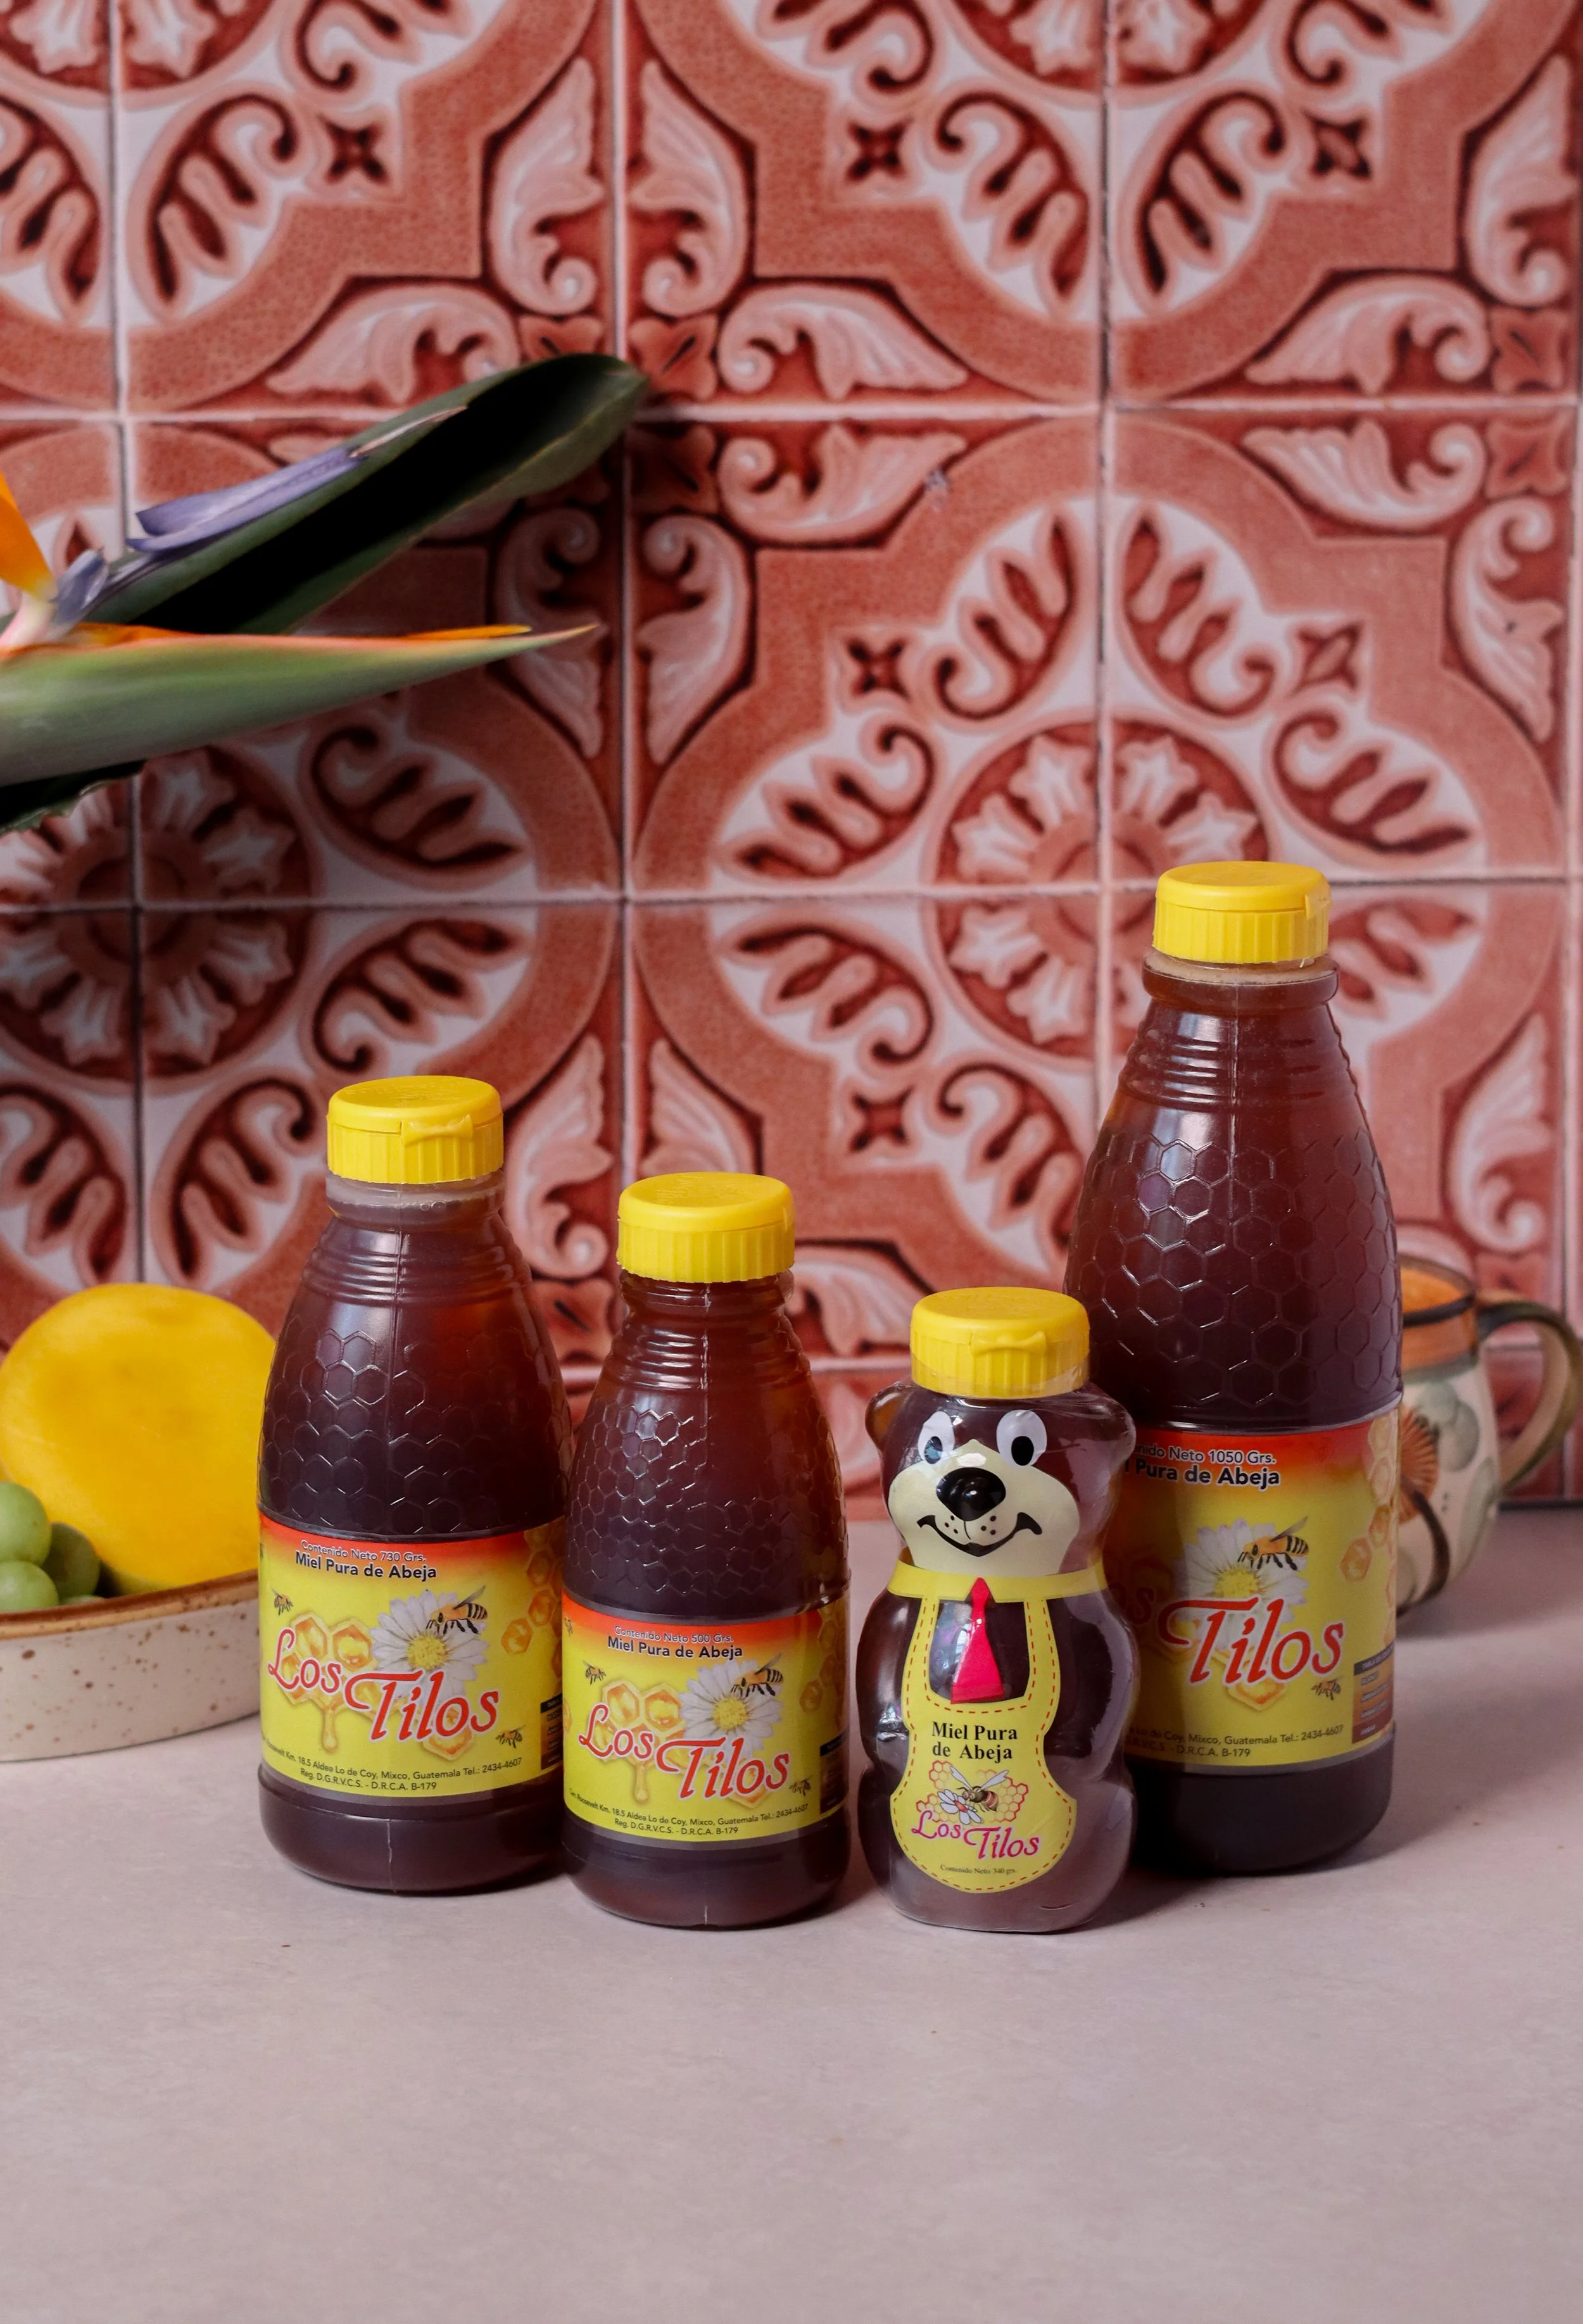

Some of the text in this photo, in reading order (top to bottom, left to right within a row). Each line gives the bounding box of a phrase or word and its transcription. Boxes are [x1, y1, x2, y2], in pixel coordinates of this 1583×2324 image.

[1170, 1447, 1204, 1462] Neto
[1209, 1450, 1242, 1463] 1050
[1247, 1452, 1276, 1463] Grs.
[1136, 1457, 1177, 1480] Pura
[1185, 1465, 1211, 1483] de
[1218, 1467, 1279, 1490] Abeja
[301, 1540, 426, 1562] Contenido Neto 730 Grs.
[296, 1550, 437, 1582] Miel Pura de Abeja
[614, 1625, 733, 1643] Contenido Neto 500 Grs.
[1157, 1596, 1344, 1684] Tilos
[608, 1636, 743, 1661] Miel Pura de Abeja
[268, 1628, 500, 1741] Los Tilos
[932, 1721, 1018, 1740] Miel Pura
[1189, 1733, 1221, 1745] Mixco,
[1225, 1735, 1277, 1745] Guatemala
[1280, 1734, 1299, 1743] Tel.:
[1301, 1724, 1343, 1741] 2434-4607
[578, 1704, 790, 1799] Los Tilos
[932, 1741, 1012, 1764] de Abeja
[1222, 1748, 1251, 1757] B-179
[298, 1756, 311, 1766] 18.5
[313, 1761, 333, 1772] Aldea
[336, 1766, 344, 1774] Lo
[381, 1771, 410, 1780] Mixco,
[413, 1769, 460, 1780] Guatemala
[463, 1768, 480, 1776] Tel.:
[482, 1757, 522, 1773] 2434-4607
[300, 1768, 314, 1780] Reg.
[317, 1773, 363, 1788] D.G.R.V.C.S.
[372, 1781, 408, 1790] D.R.C.A.
[412, 1782, 437, 1790] B-179
[612, 1808, 625, 1817] 18.5
[627, 1812, 646, 1821] Aldea
[776, 1804, 809, 1818] 2434-4607
[614, 1818, 628, 1828] Reg.
[911, 1810, 1040, 1860] Los Tilos
